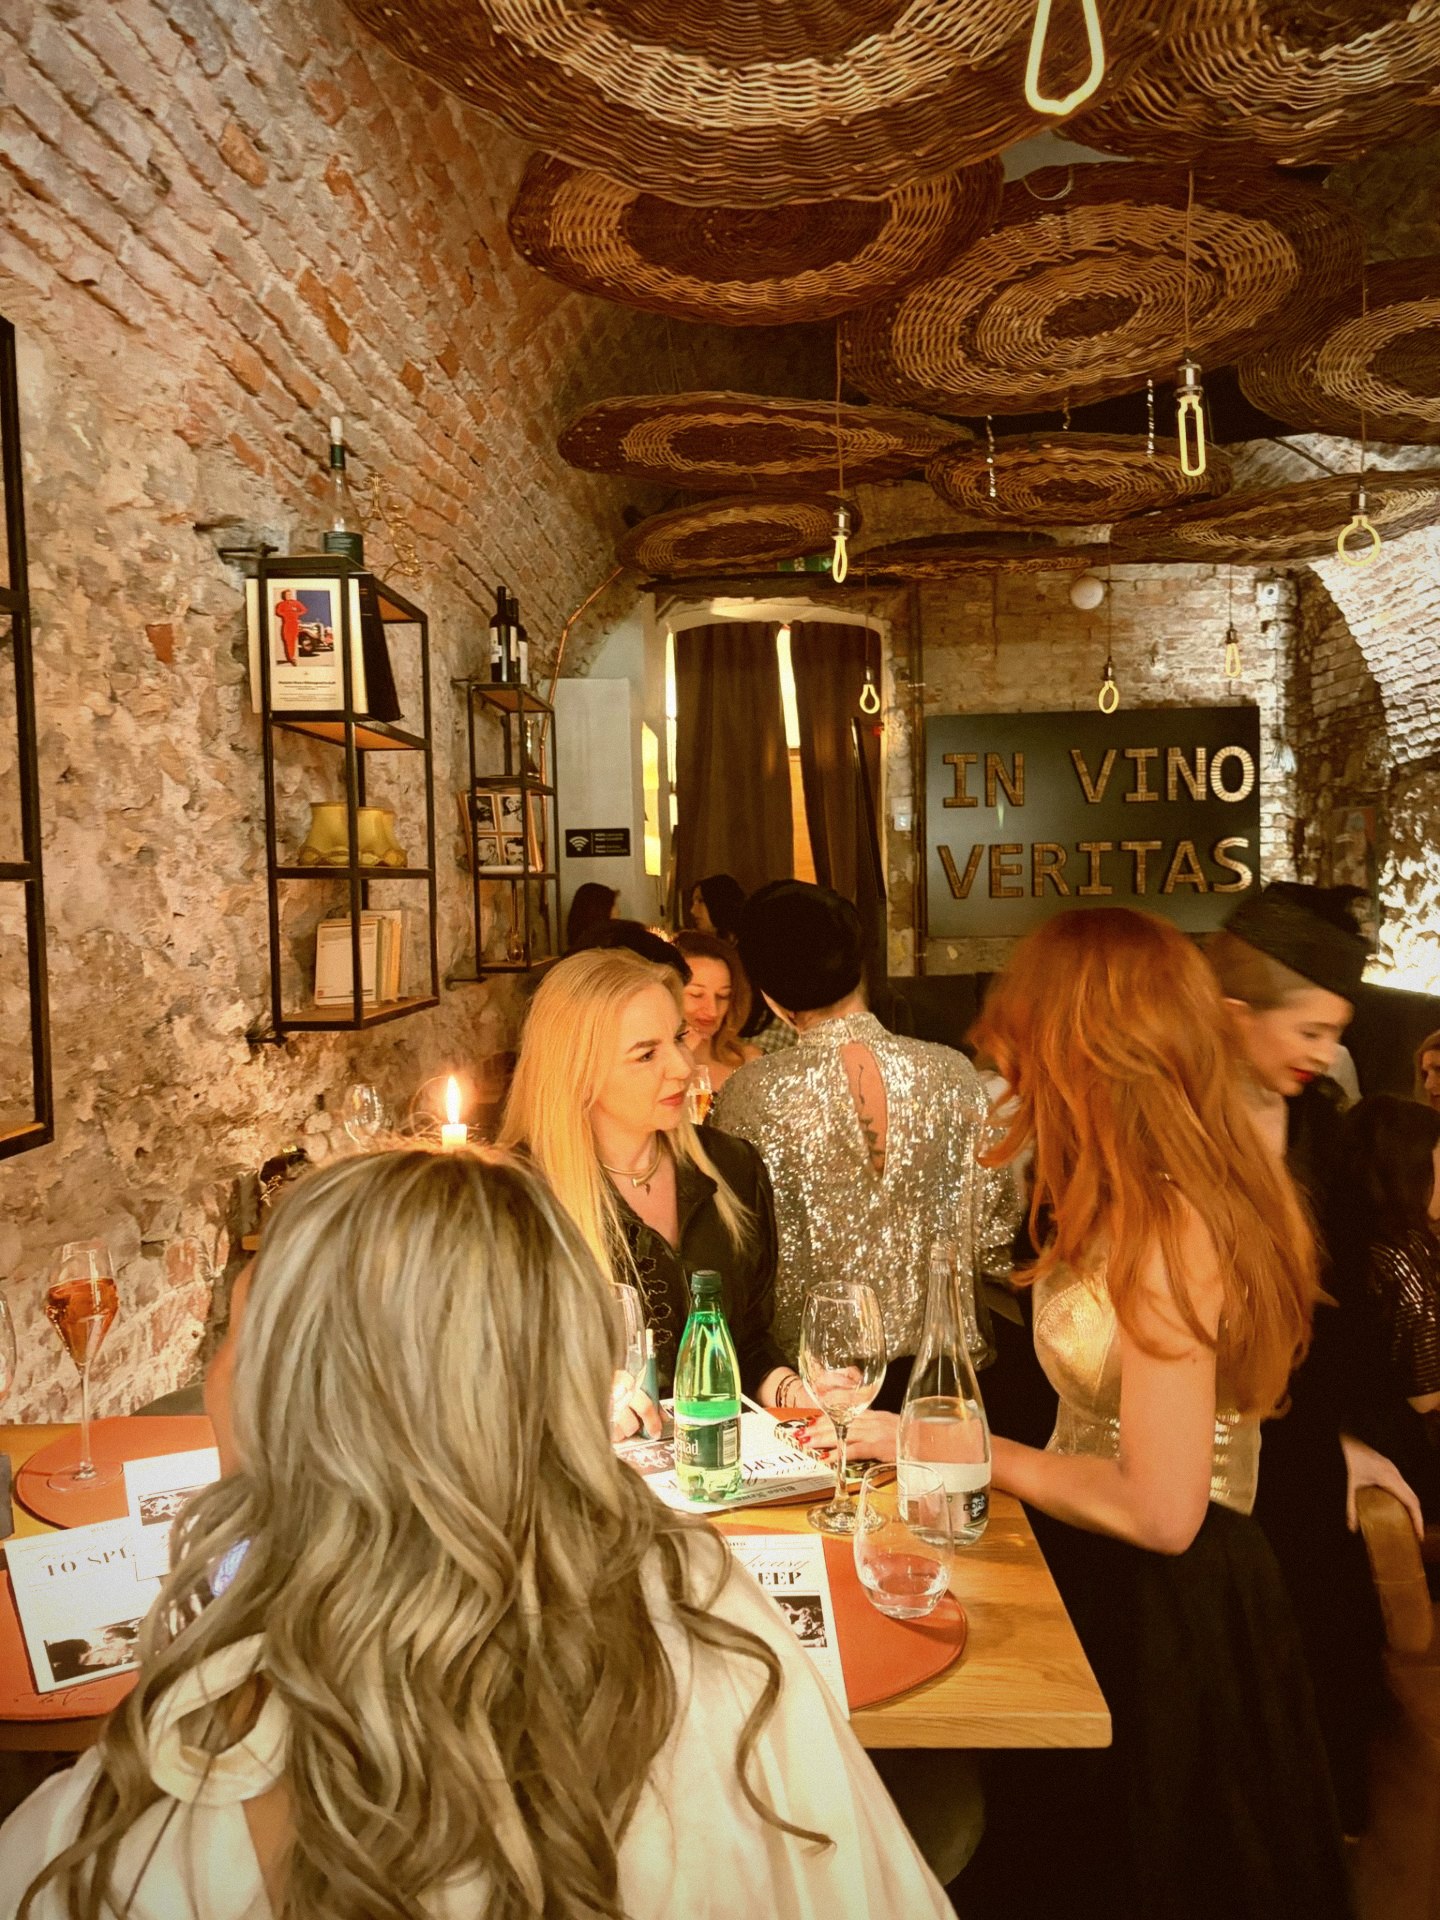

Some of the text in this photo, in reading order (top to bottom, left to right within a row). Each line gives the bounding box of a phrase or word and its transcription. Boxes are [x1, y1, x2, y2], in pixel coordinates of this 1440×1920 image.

[942, 745, 1255, 808] IN VINO
[937, 836, 1253, 899] VERITAS
[758, 1571, 802, 1585] EEP
